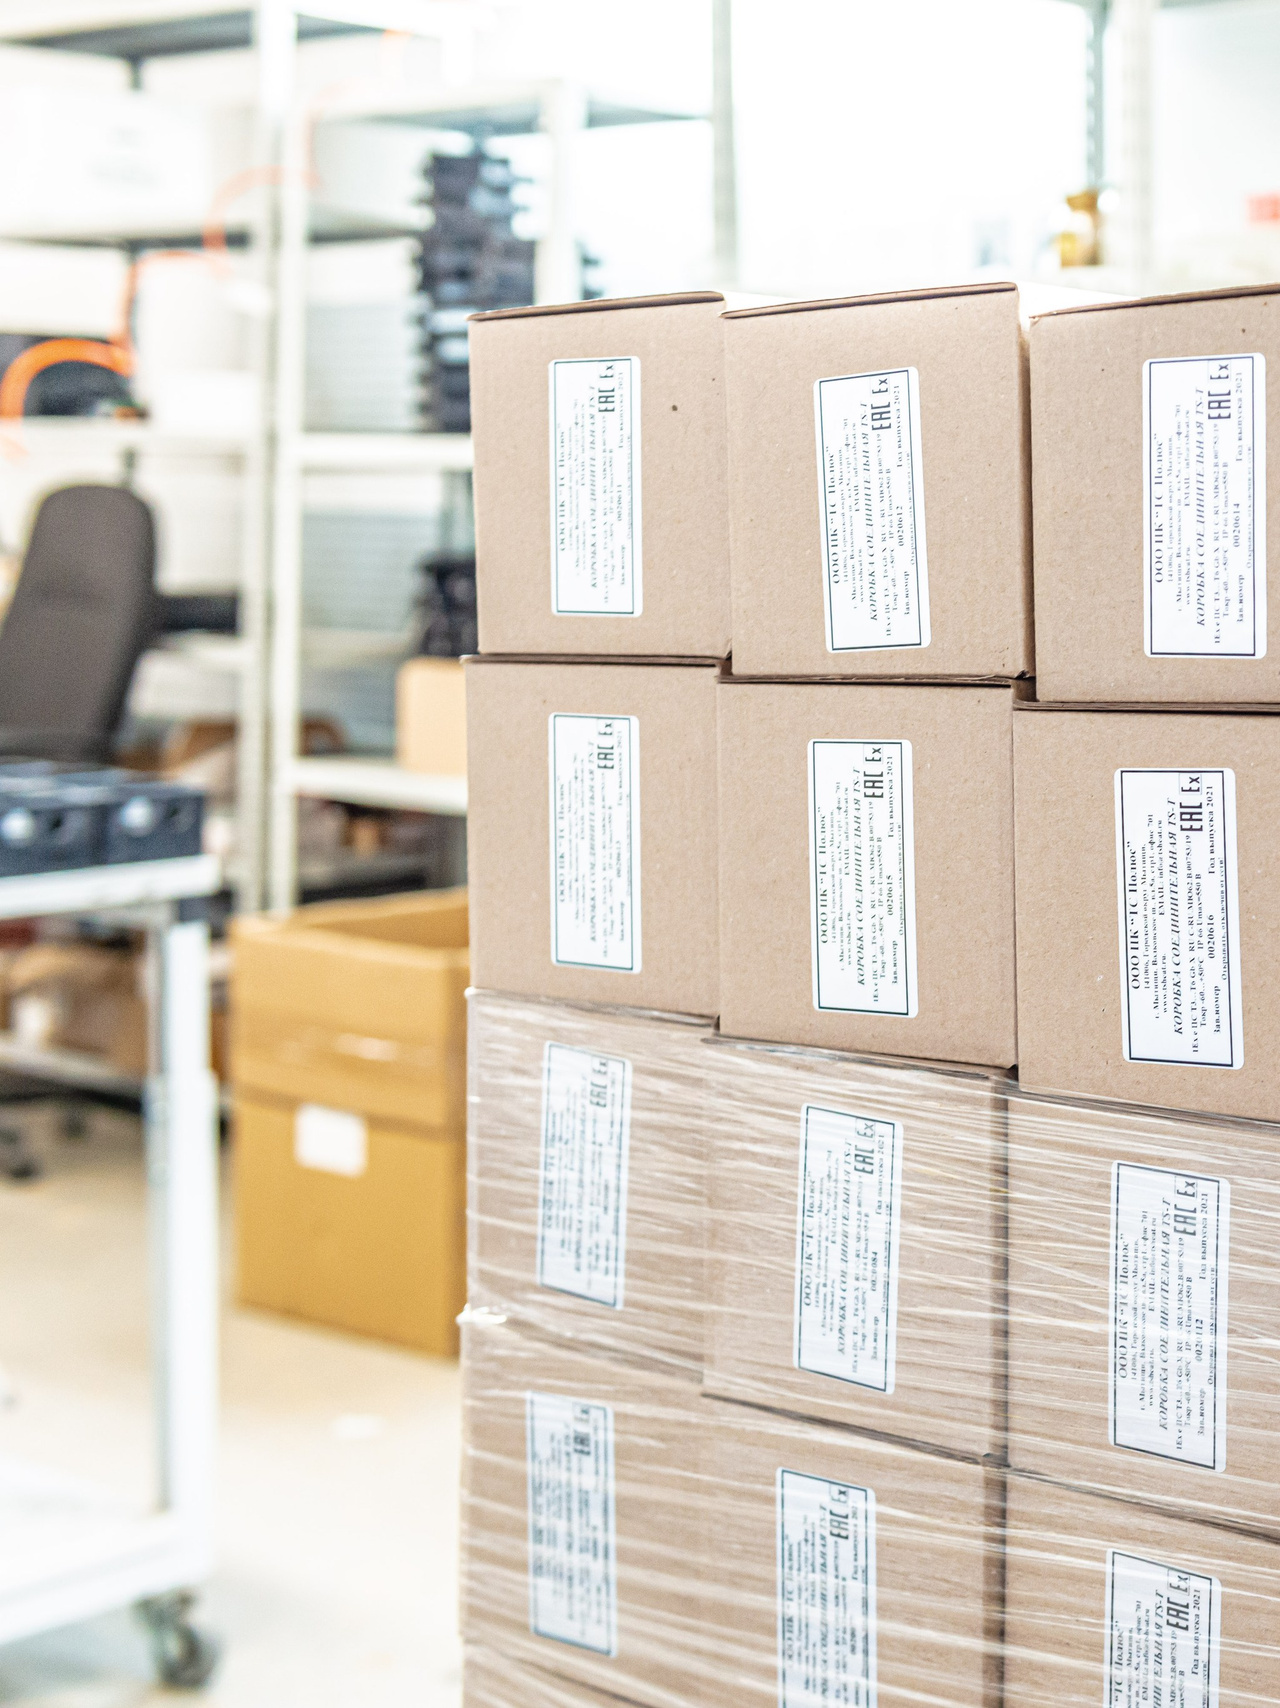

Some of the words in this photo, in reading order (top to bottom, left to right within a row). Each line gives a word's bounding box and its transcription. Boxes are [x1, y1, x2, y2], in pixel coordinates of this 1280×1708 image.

[871, 377, 888, 394] Ex
[1209, 362, 1229, 380] Ex
[870, 401, 891, 431] EAC
[1207, 389, 1230, 420] EAC
[896, 505, 904, 546] 0020612
[1232, 502, 1240, 546] 0020614
[864, 747, 881, 761] Ex
[852, 766, 860, 792] TS-T
[863, 770, 884, 798] EAC
[1180, 776, 1200, 792] Ex
[1205, 785, 1213, 807] 2021
[818, 806, 826, 853] Полюс”
[1207, 810, 1216, 853] выпуска
[819, 858, 827, 883] “ТС
[853, 797, 864, 921] СОЕДИНИТЕЛЬНАЯ
[819, 887, 827, 907] ПК
[886, 874, 894, 914] 0020615
[1167, 831, 1180, 965] СОЕДИНИТЕЛЬНАЯ
[820, 911, 828, 943] ООО
[1129, 929, 1138, 950] ПК
[1206, 914, 1215, 958] 0020616
[856, 925, 865, 985] КОРОБКА
[891, 939, 899, 984] Зав.номер
[1130, 955, 1140, 989] ООО
[1172, 969, 1182, 1034] КОРОБКА
[1212, 985, 1221, 1033] Зав.номер
[1170, 1575, 1189, 1593] Ex
[1167, 1597, 1189, 1631] EAC
